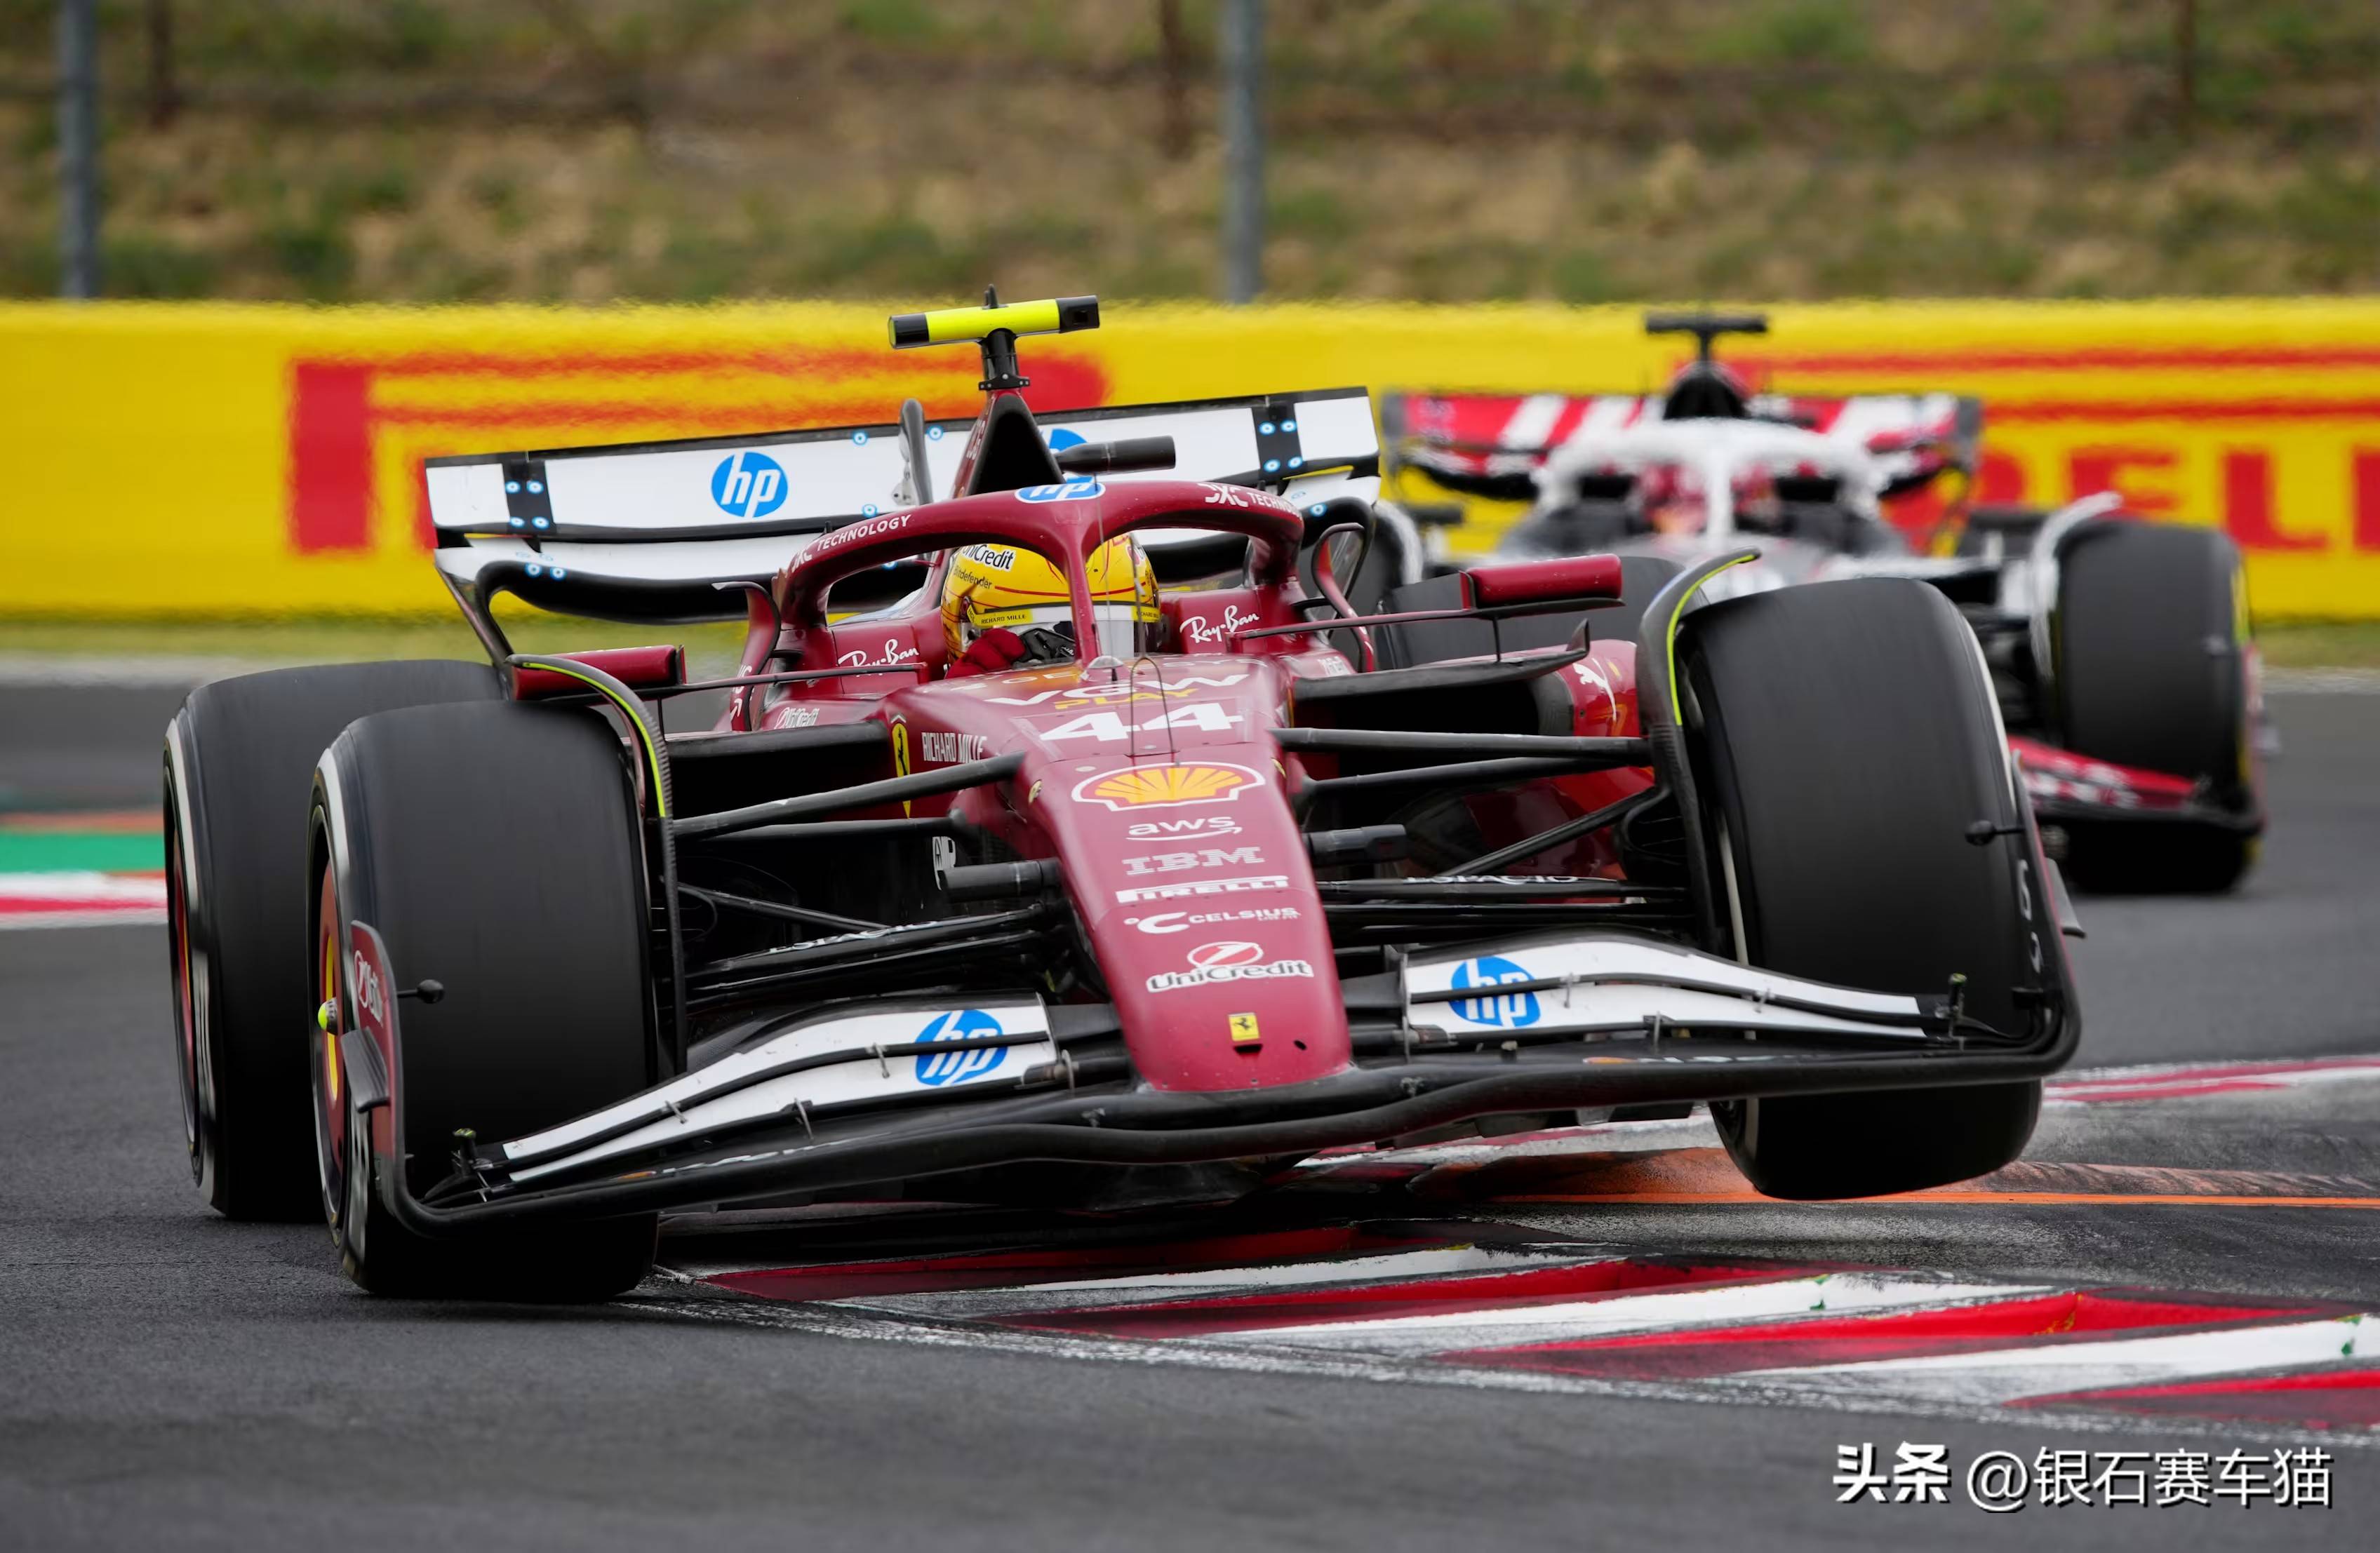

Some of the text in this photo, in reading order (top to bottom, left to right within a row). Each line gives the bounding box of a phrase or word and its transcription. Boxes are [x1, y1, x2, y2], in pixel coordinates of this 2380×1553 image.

[716, 450, 784, 518] hp
[816, 514, 911, 551] TECHNOLOGY
[1179, 605, 1259, 643] Ray-Ban
[984, 674, 1249, 706] VGW
[1040, 702, 1244, 741] 44
[921, 732, 987, 764] RICHARD MILLE
[1128, 816, 1236, 835] aws
[1122, 847, 1265, 875] IBM
[1116, 875, 1289, 903] PIRELLI
[1189, 908, 1301, 923] CELSIUS
[1149, 961, 1311, 990] UniCredit
[1457, 957, 1534, 1028] hp
[918, 1009, 1002, 1087] hp
